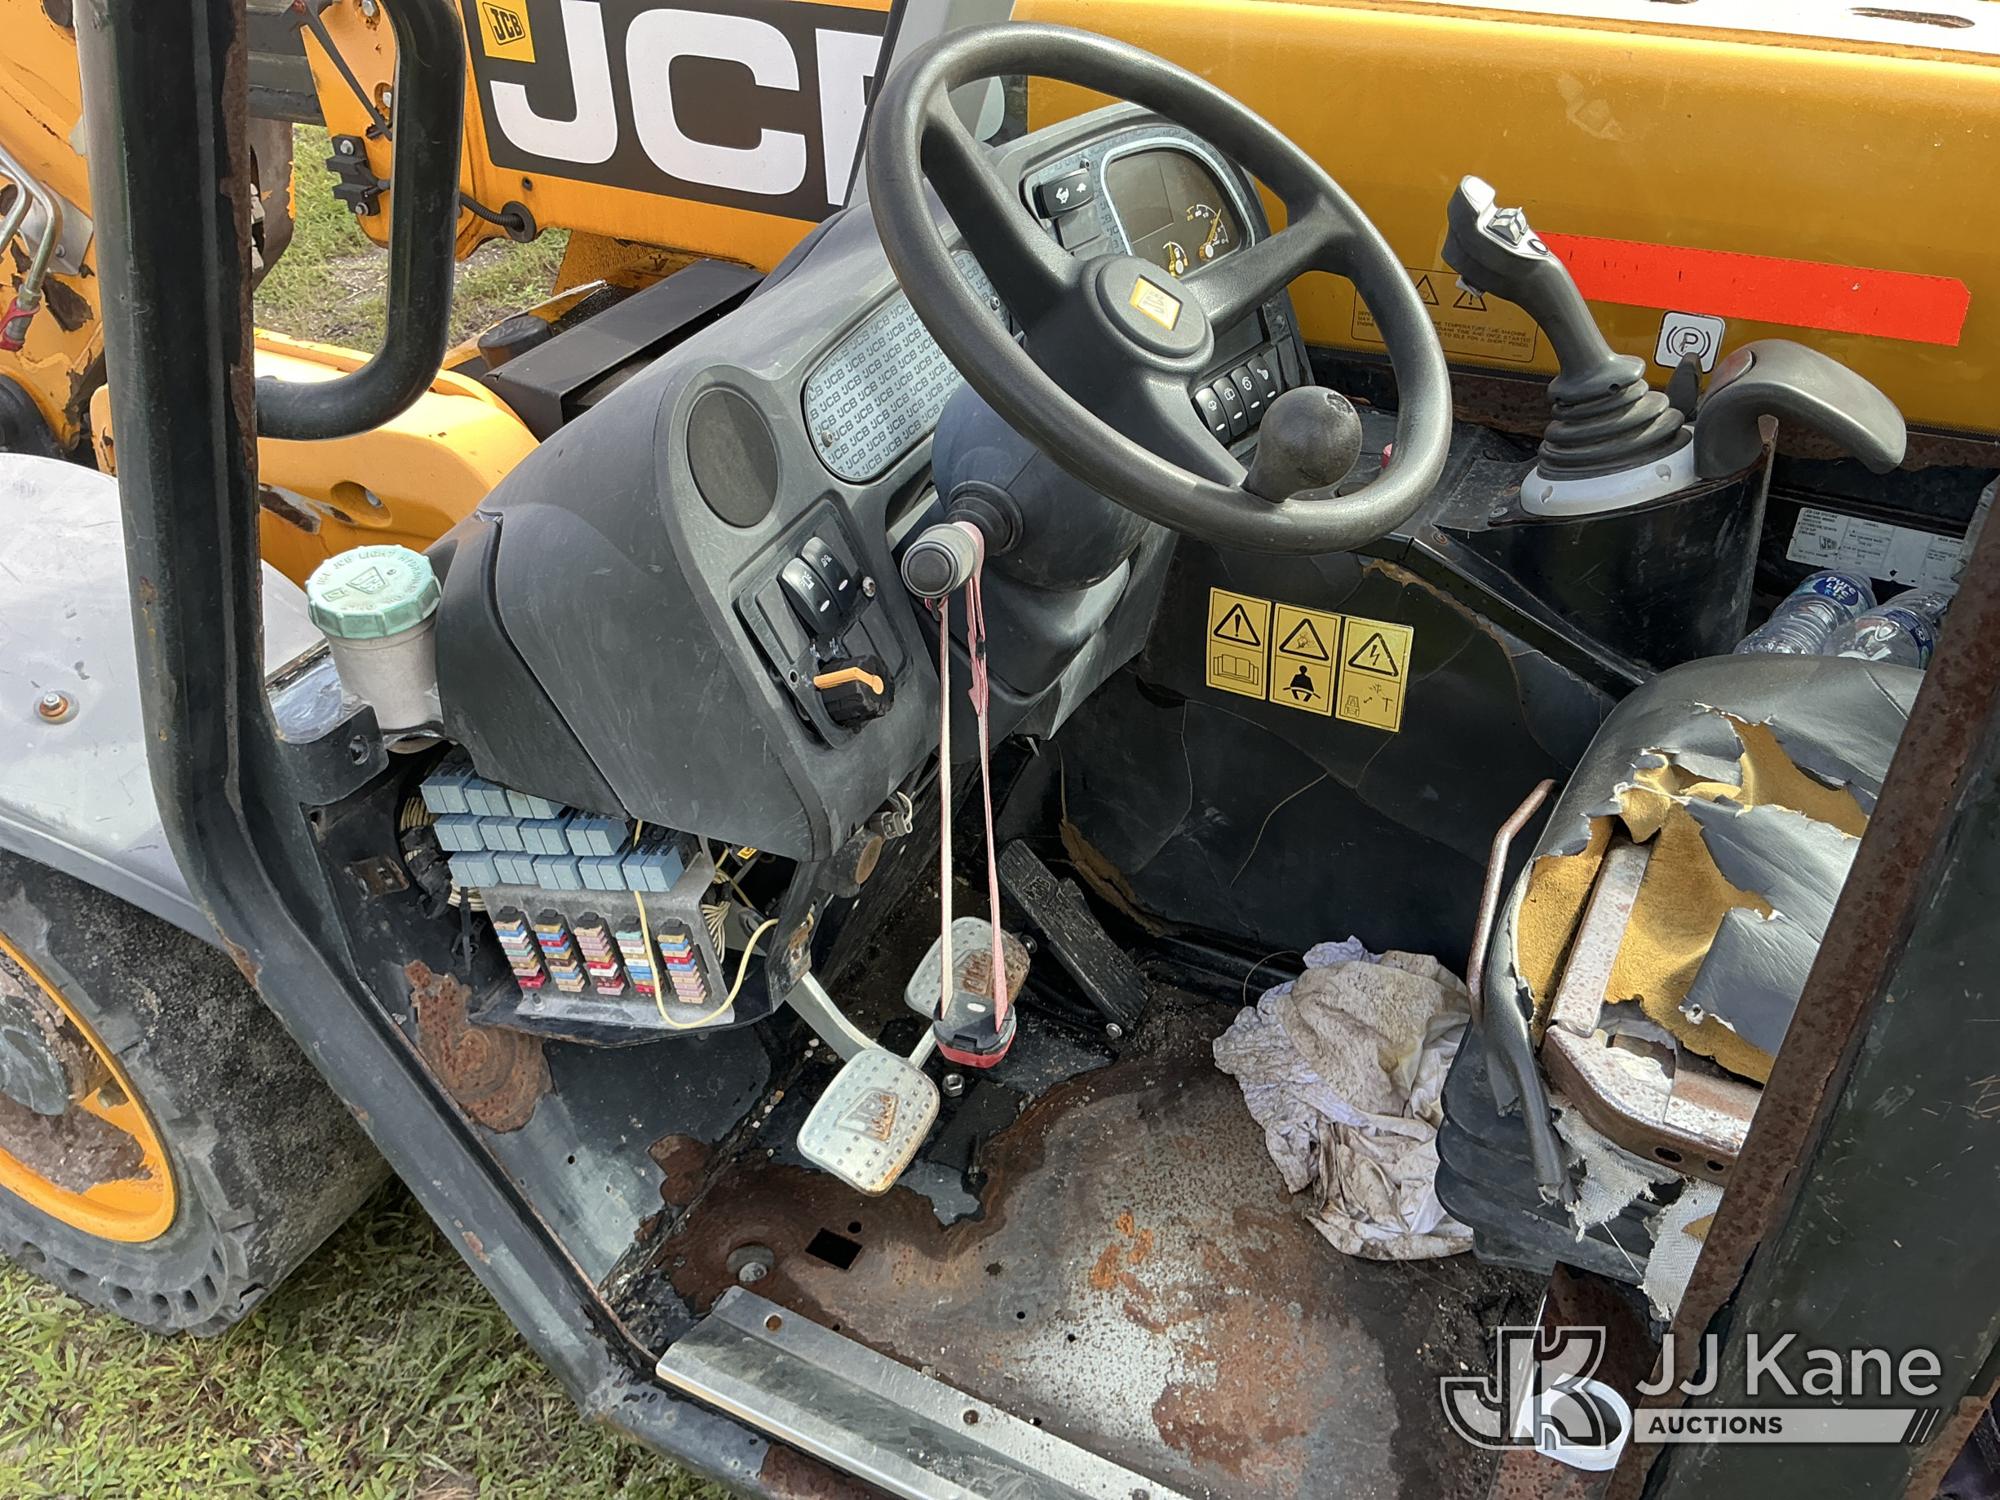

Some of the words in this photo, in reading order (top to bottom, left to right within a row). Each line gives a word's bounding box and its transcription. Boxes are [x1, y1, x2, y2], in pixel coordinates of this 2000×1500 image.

[490, 7, 523, 41] JCB
[824, 369, 845, 389] JCB
[846, 353, 866, 373] JCB
[866, 337, 886, 357] JCB
[886, 321, 906, 341] JCB
[870, 315, 890, 335] JCB
[1680, 332, 1699, 352] P
[820, 392, 841, 412] JCB
[841, 374, 862, 395] JCB
[862, 359, 882, 379] JCB
[882, 343, 902, 363] JCB
[902, 328, 921, 347] JCB
[832, 420, 854, 441] JCB
[854, 403, 874, 424] JCB
[874, 387, 894, 407] JCB
[894, 371, 914, 391] JCB
[914, 355, 933, 375] JCB
[837, 397, 858, 418] JCB
[858, 381, 878, 401] JCB
[878, 365, 898, 385] JCB
[898, 349, 917, 369] JCB
[828, 442, 849, 464] JCB
[850, 425, 870, 447] JCB
[870, 409, 891, 430] JCB
[890, 392, 910, 413] JCB
[910, 377, 929, 397] JCB
[929, 361, 947, 380] JCB
[845, 448, 866, 470] JCB
[866, 431, 887, 452] JCB
[886, 414, 906, 435] JCB
[906, 398, 925, 418] JCB
[925, 382, 944, 402] JCB
[882, 437, 903, 457] JCB
[902, 419, 921, 440] JCB
